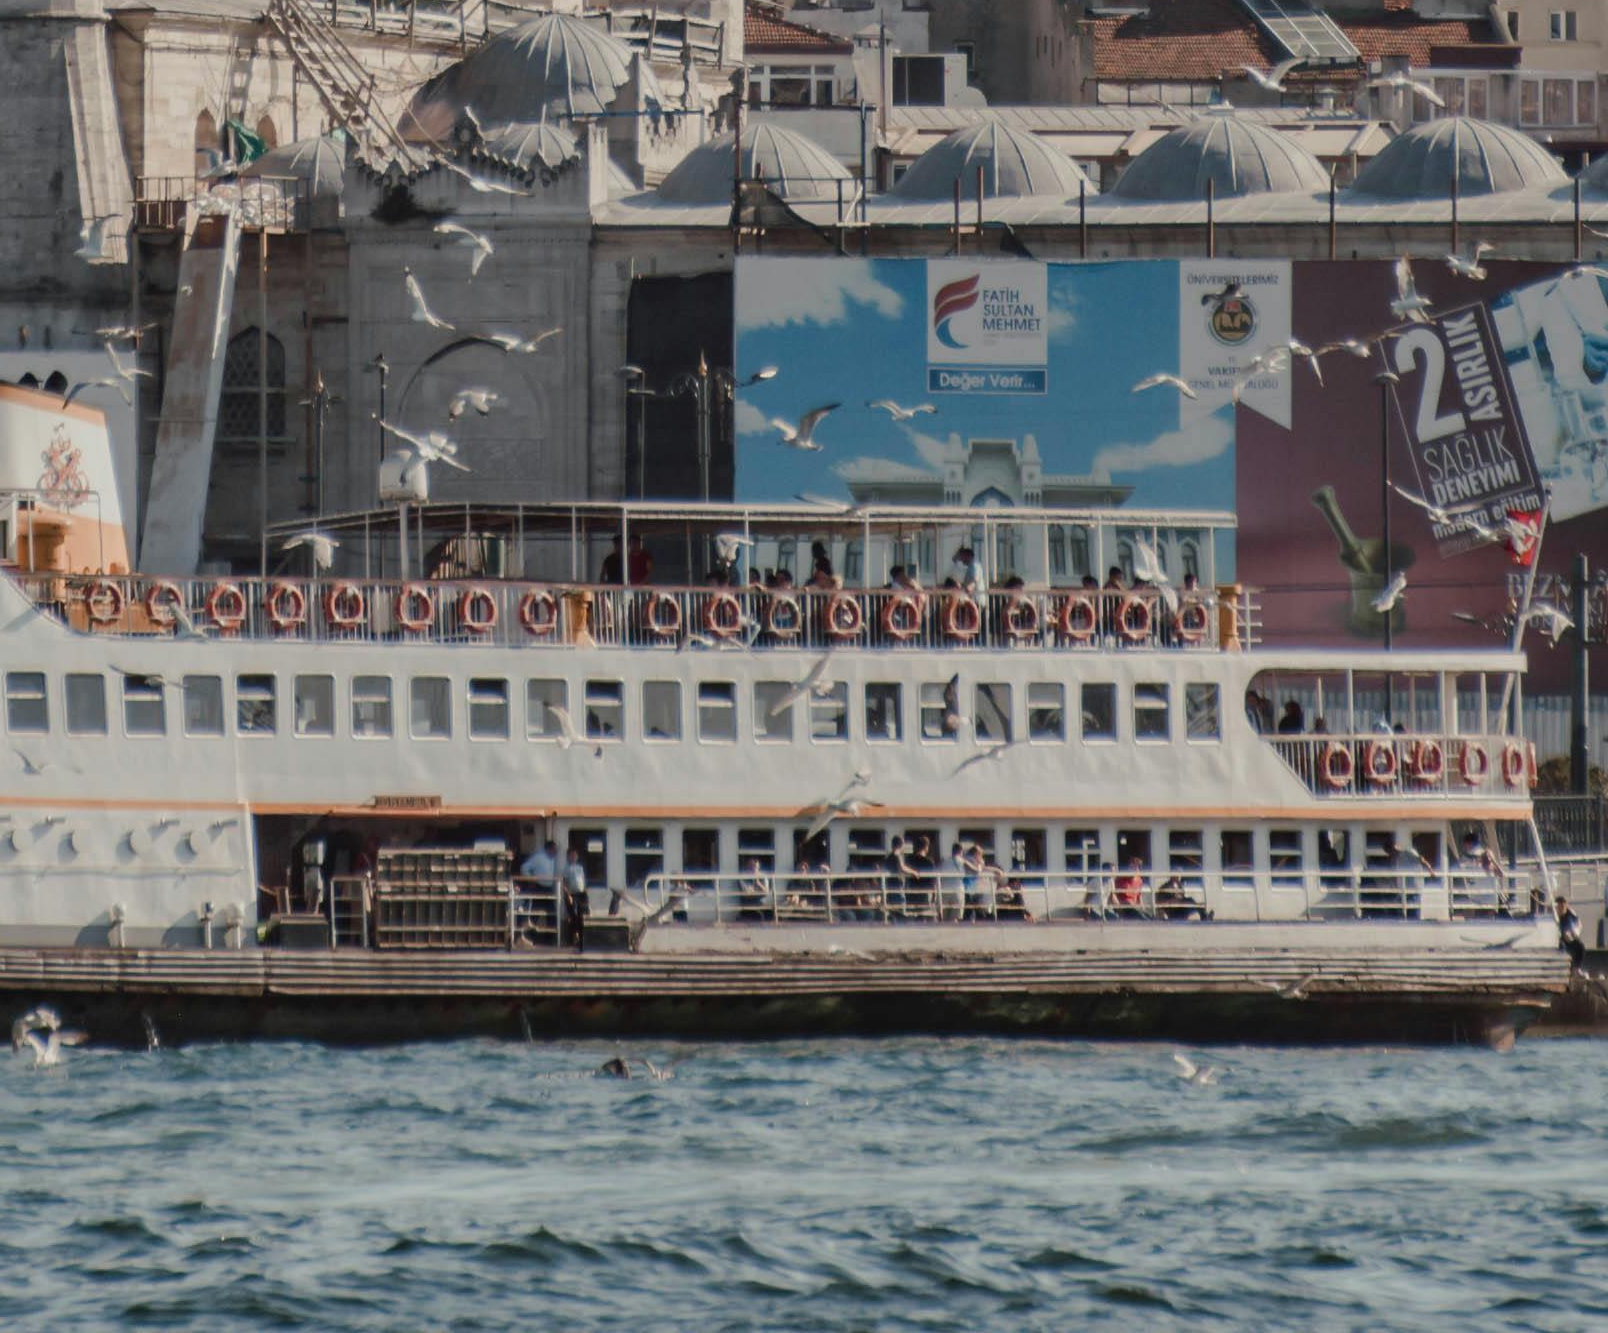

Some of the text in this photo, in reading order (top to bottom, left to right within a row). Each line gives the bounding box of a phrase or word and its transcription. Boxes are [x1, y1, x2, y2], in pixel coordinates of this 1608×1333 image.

[982, 287, 1020, 303] FATİH
[983, 304, 1034, 317] SULTAN
[982, 318, 1041, 332] MEHMET
[1207, 365, 1250, 376] VAKIF
[1395, 311, 1503, 444] 2 ASIRLIK
[939, 372, 985, 390] Değer
[1423, 426, 1515, 482] SAĞLIK
[1492, 493, 1541, 521] eğitim
